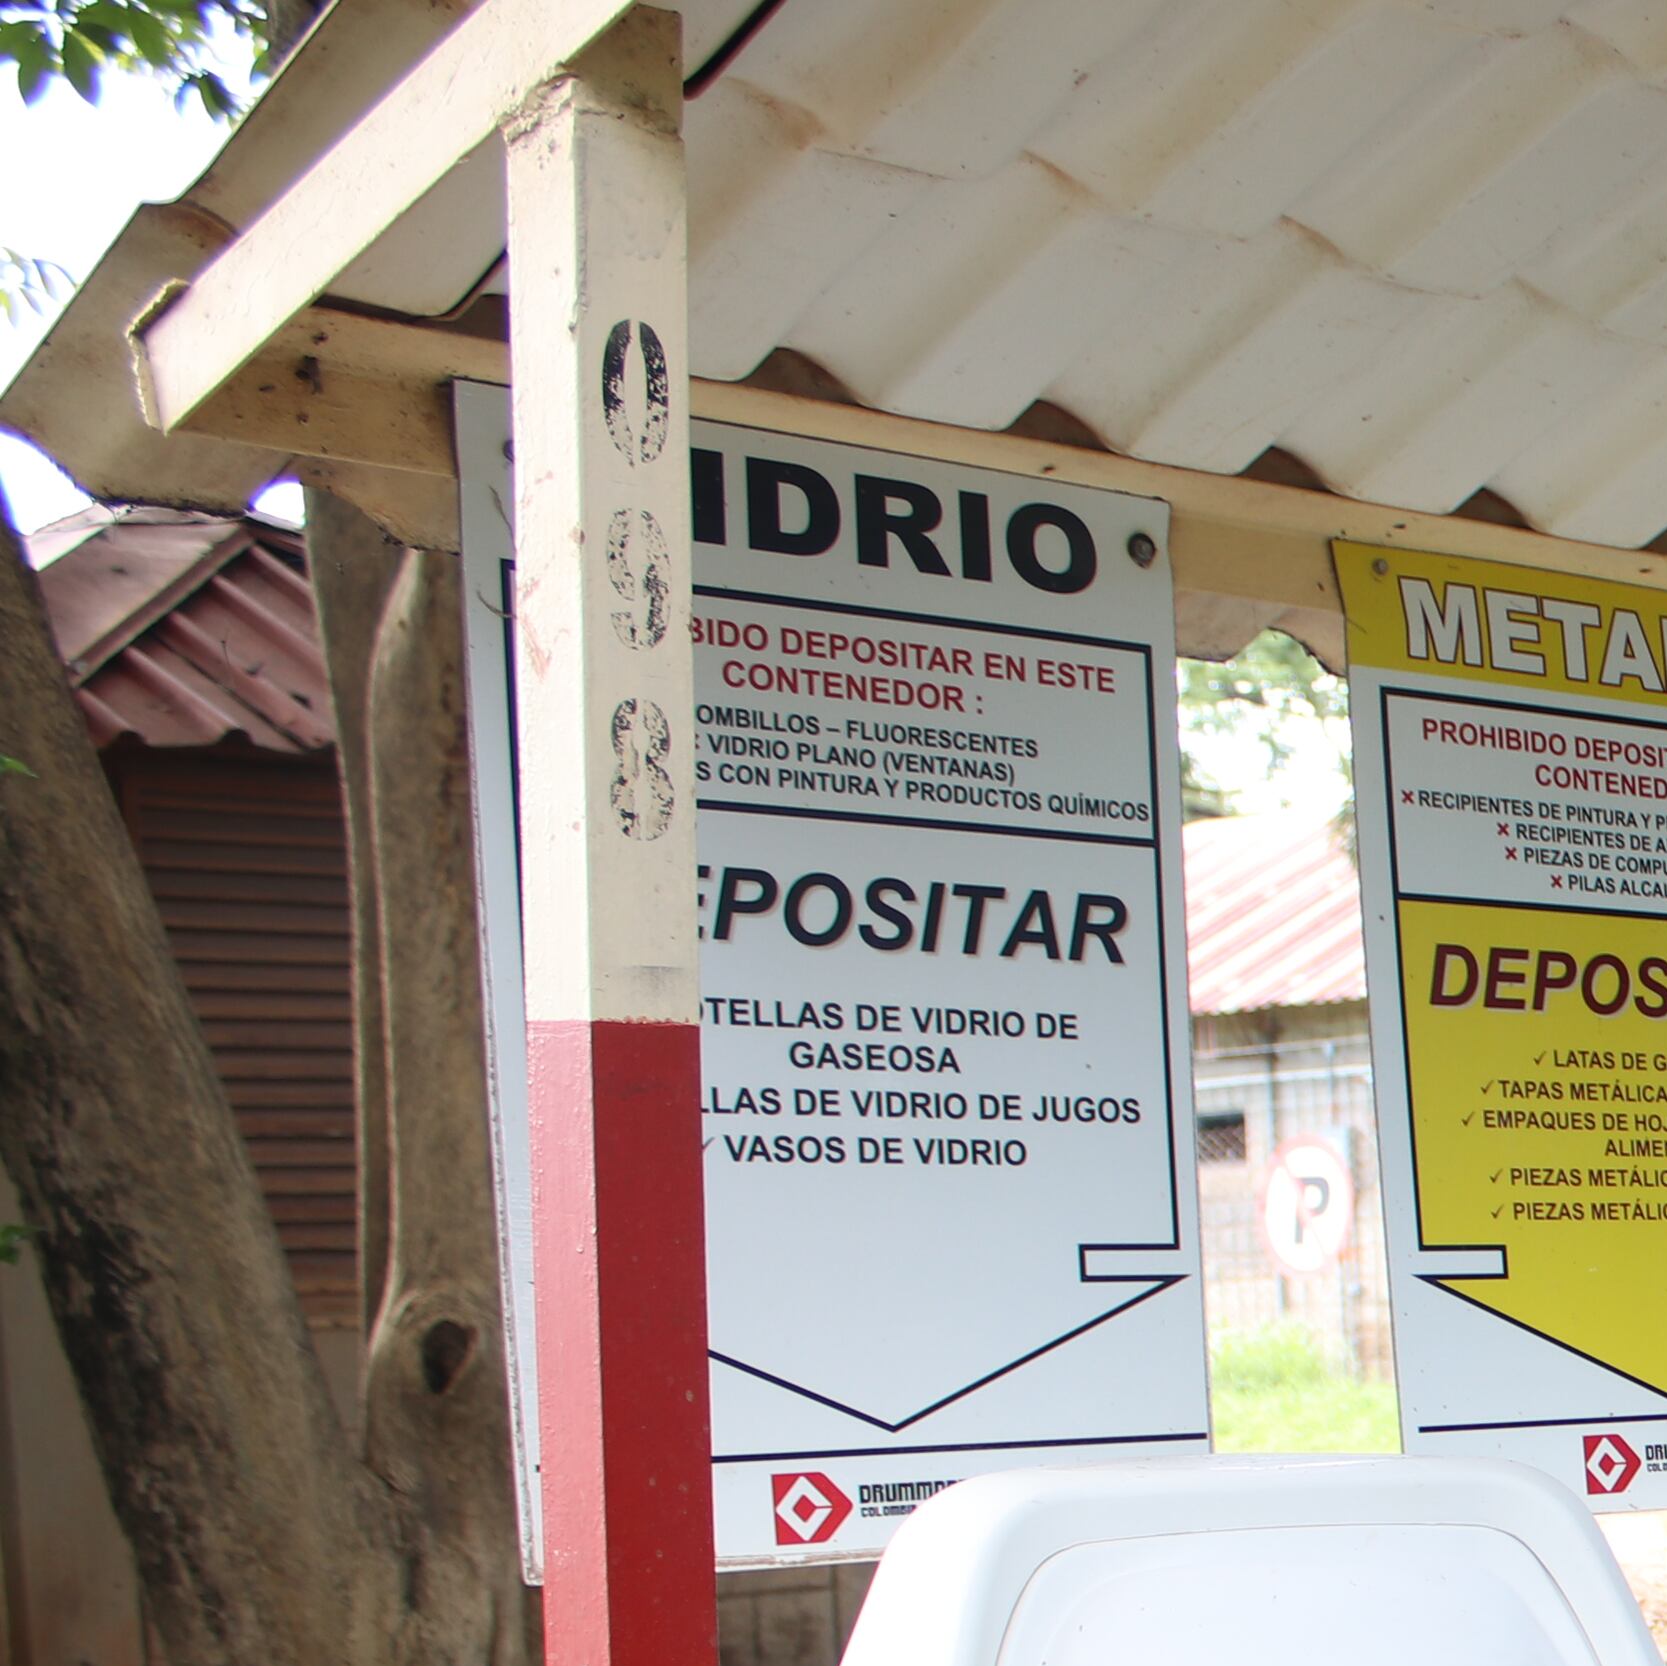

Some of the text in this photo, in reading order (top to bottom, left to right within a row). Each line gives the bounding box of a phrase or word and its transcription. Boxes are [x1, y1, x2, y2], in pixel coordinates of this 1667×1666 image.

[692, 448, 1097, 594] IDRIO
[782, 628, 972, 678] DEPOSITAR
[985, 650, 1026, 683] EN
[1037, 657, 1115, 693] ESTE
[722, 662, 965, 712] CONTENEDOR
[695, 705, 1038, 759] OMBILLOS FLUORESCENTES
[1422, 718, 1566, 755] PROHIBIDO
[709, 732, 1014, 786] VIDRIO PLANO (VENTANAS)
[719, 762, 1149, 822] CON PINTURA Y PRODUCTOS QUÍMICOS
[1418, 790, 1533, 817] RECIPIENTES
[1538, 799, 1562, 820] DE
[1566, 802, 1637, 828] PINTURA
[1641, 810, 1650, 829] Y
[1517, 824, 1627, 850] RECIPIENTES
[1631, 834, 1650, 853] DE
[1524, 847, 1584, 869] PIEZAS
[1589, 853, 1611, 872] DE
[1568, 875, 1615, 894] PILAS
[698, 866, 1129, 966] POSITAR
[701, 998, 1078, 1040] TELLAS DE VIDRIO DE
[789, 1041, 960, 1074] GASEOSA
[1554, 1050, 1615, 1071] LATAS
[1622, 1052, 1647, 1072] DE
[794, 1090, 840, 1118] DE
[852, 1091, 967, 1121] VIDRIO
[979, 1095, 1022, 1122] DE
[1032, 1096, 1140, 1124] JUGOS
[1499, 1079, 1564, 1100] TAPAS
[1483, 1111, 1596, 1134] EMPAQUES
[1602, 1113, 1629, 1134] DE
[724, 1135, 1028, 1166] VASOS DE VIDRIO
[1513, 1202, 1584, 1220] PIEZAS
